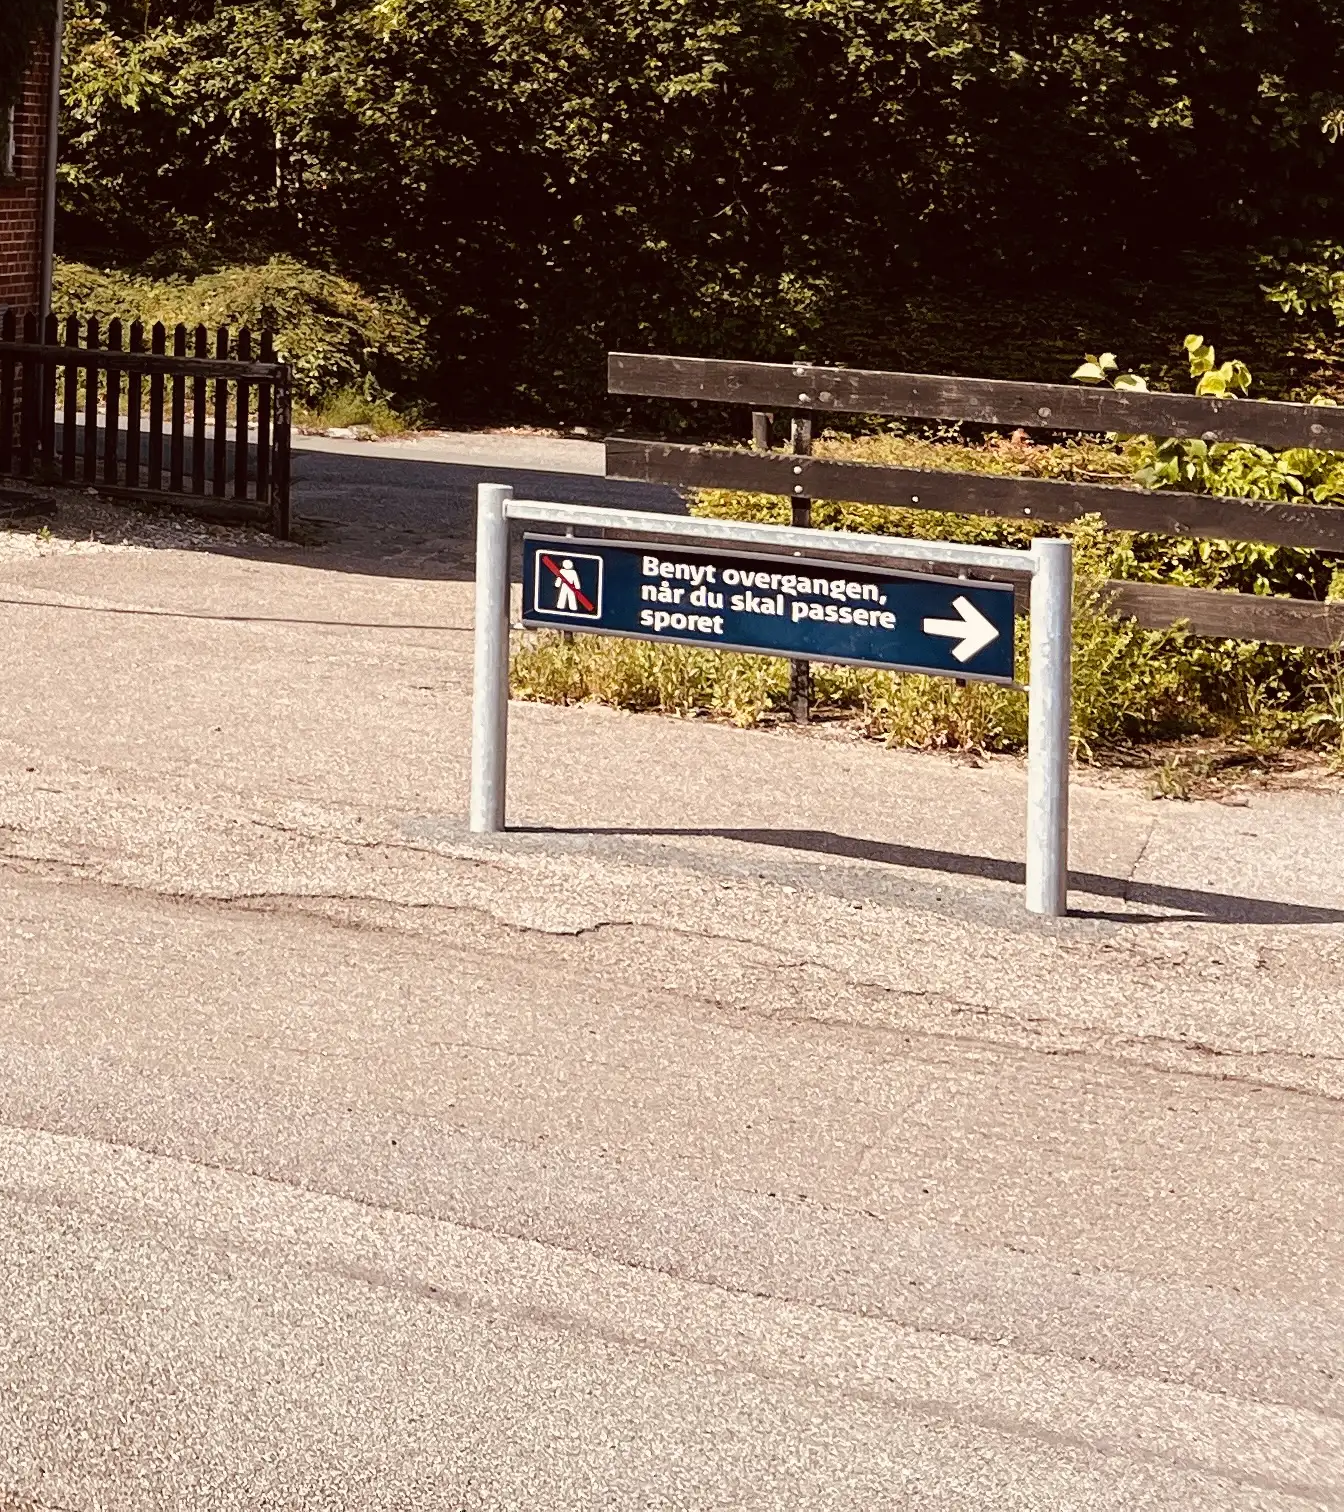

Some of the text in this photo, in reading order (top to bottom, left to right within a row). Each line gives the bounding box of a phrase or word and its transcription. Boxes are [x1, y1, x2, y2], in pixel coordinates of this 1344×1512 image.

[641, 580, 897, 629] når du skal passere
[642, 555, 888, 606] Benyt overgangen,
[640, 609, 724, 635] sporet
